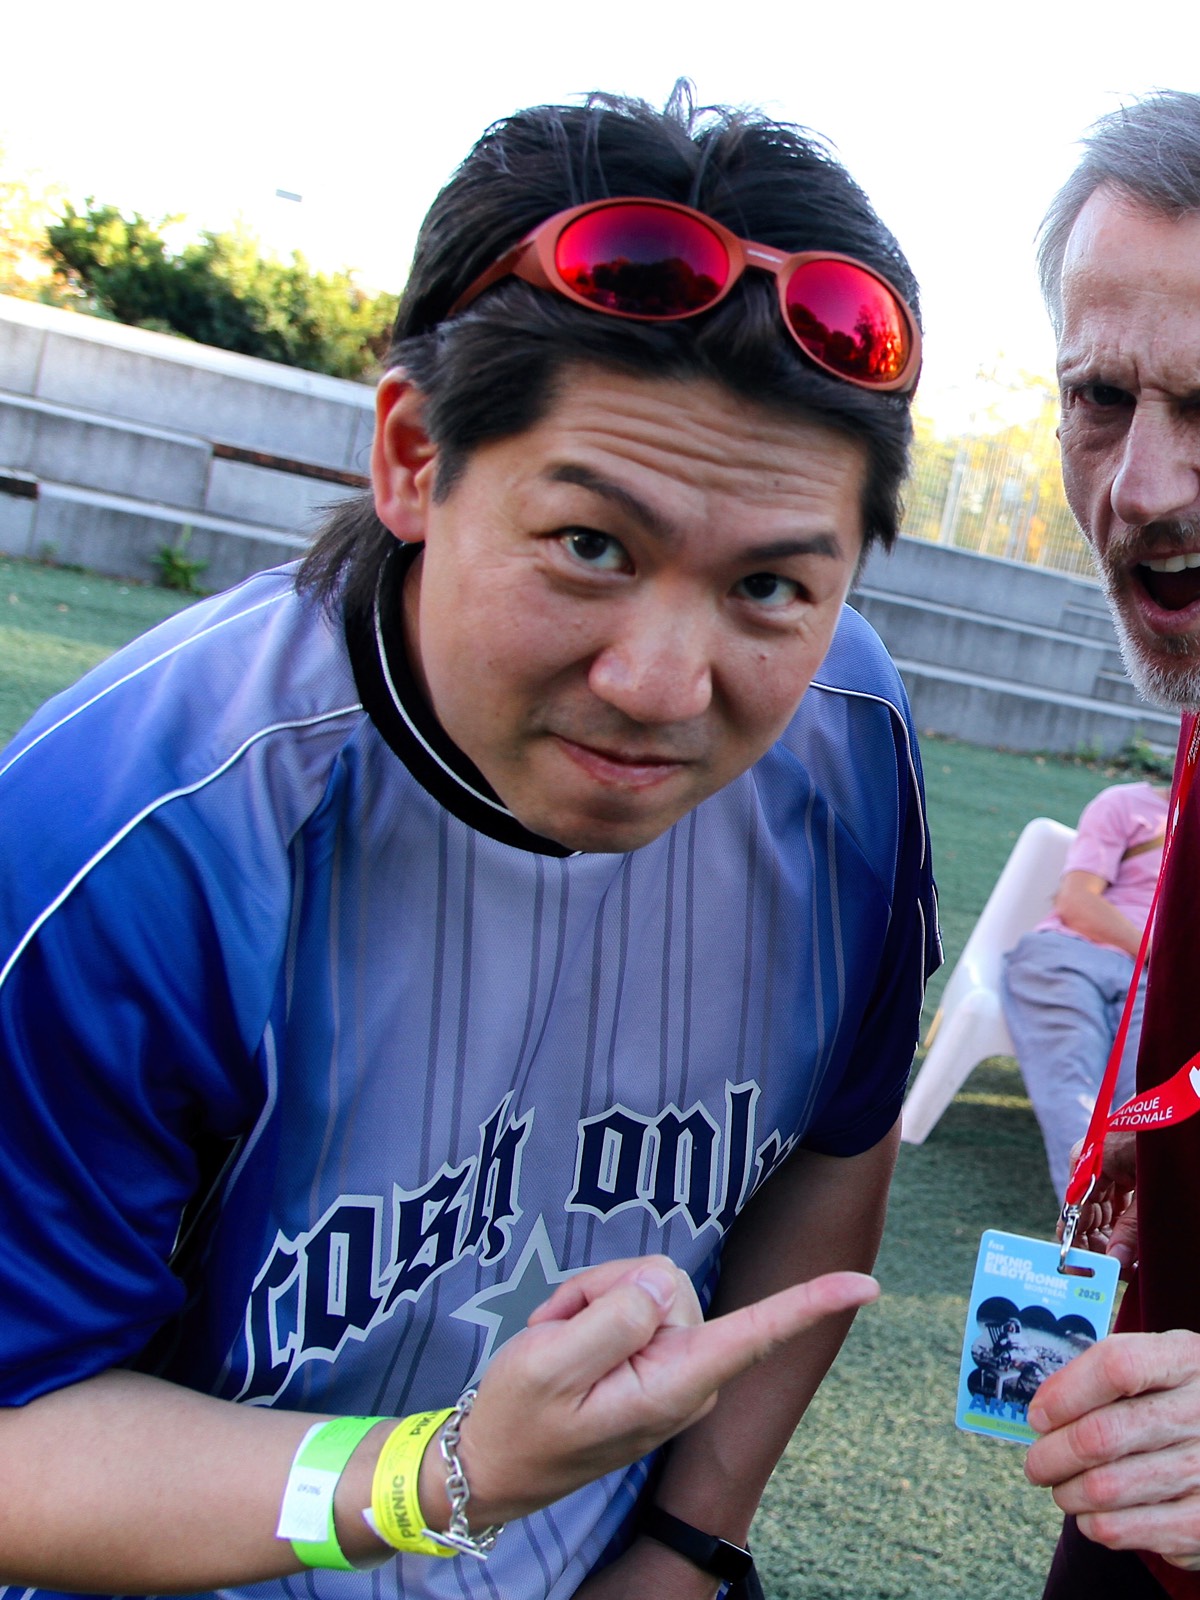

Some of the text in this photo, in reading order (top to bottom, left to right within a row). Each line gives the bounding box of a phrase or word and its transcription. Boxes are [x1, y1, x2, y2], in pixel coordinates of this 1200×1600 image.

[1109, 1106, 1173, 1127] ATIONALE
[1115, 1096, 1160, 1117] ANQUE
[985, 1251, 1033, 1271] PIKNIC
[1078, 1287, 1101, 1301] 2025
[969, 1393, 1029, 1423] ARTI
[392, 1475, 416, 1539] PIKNIC
